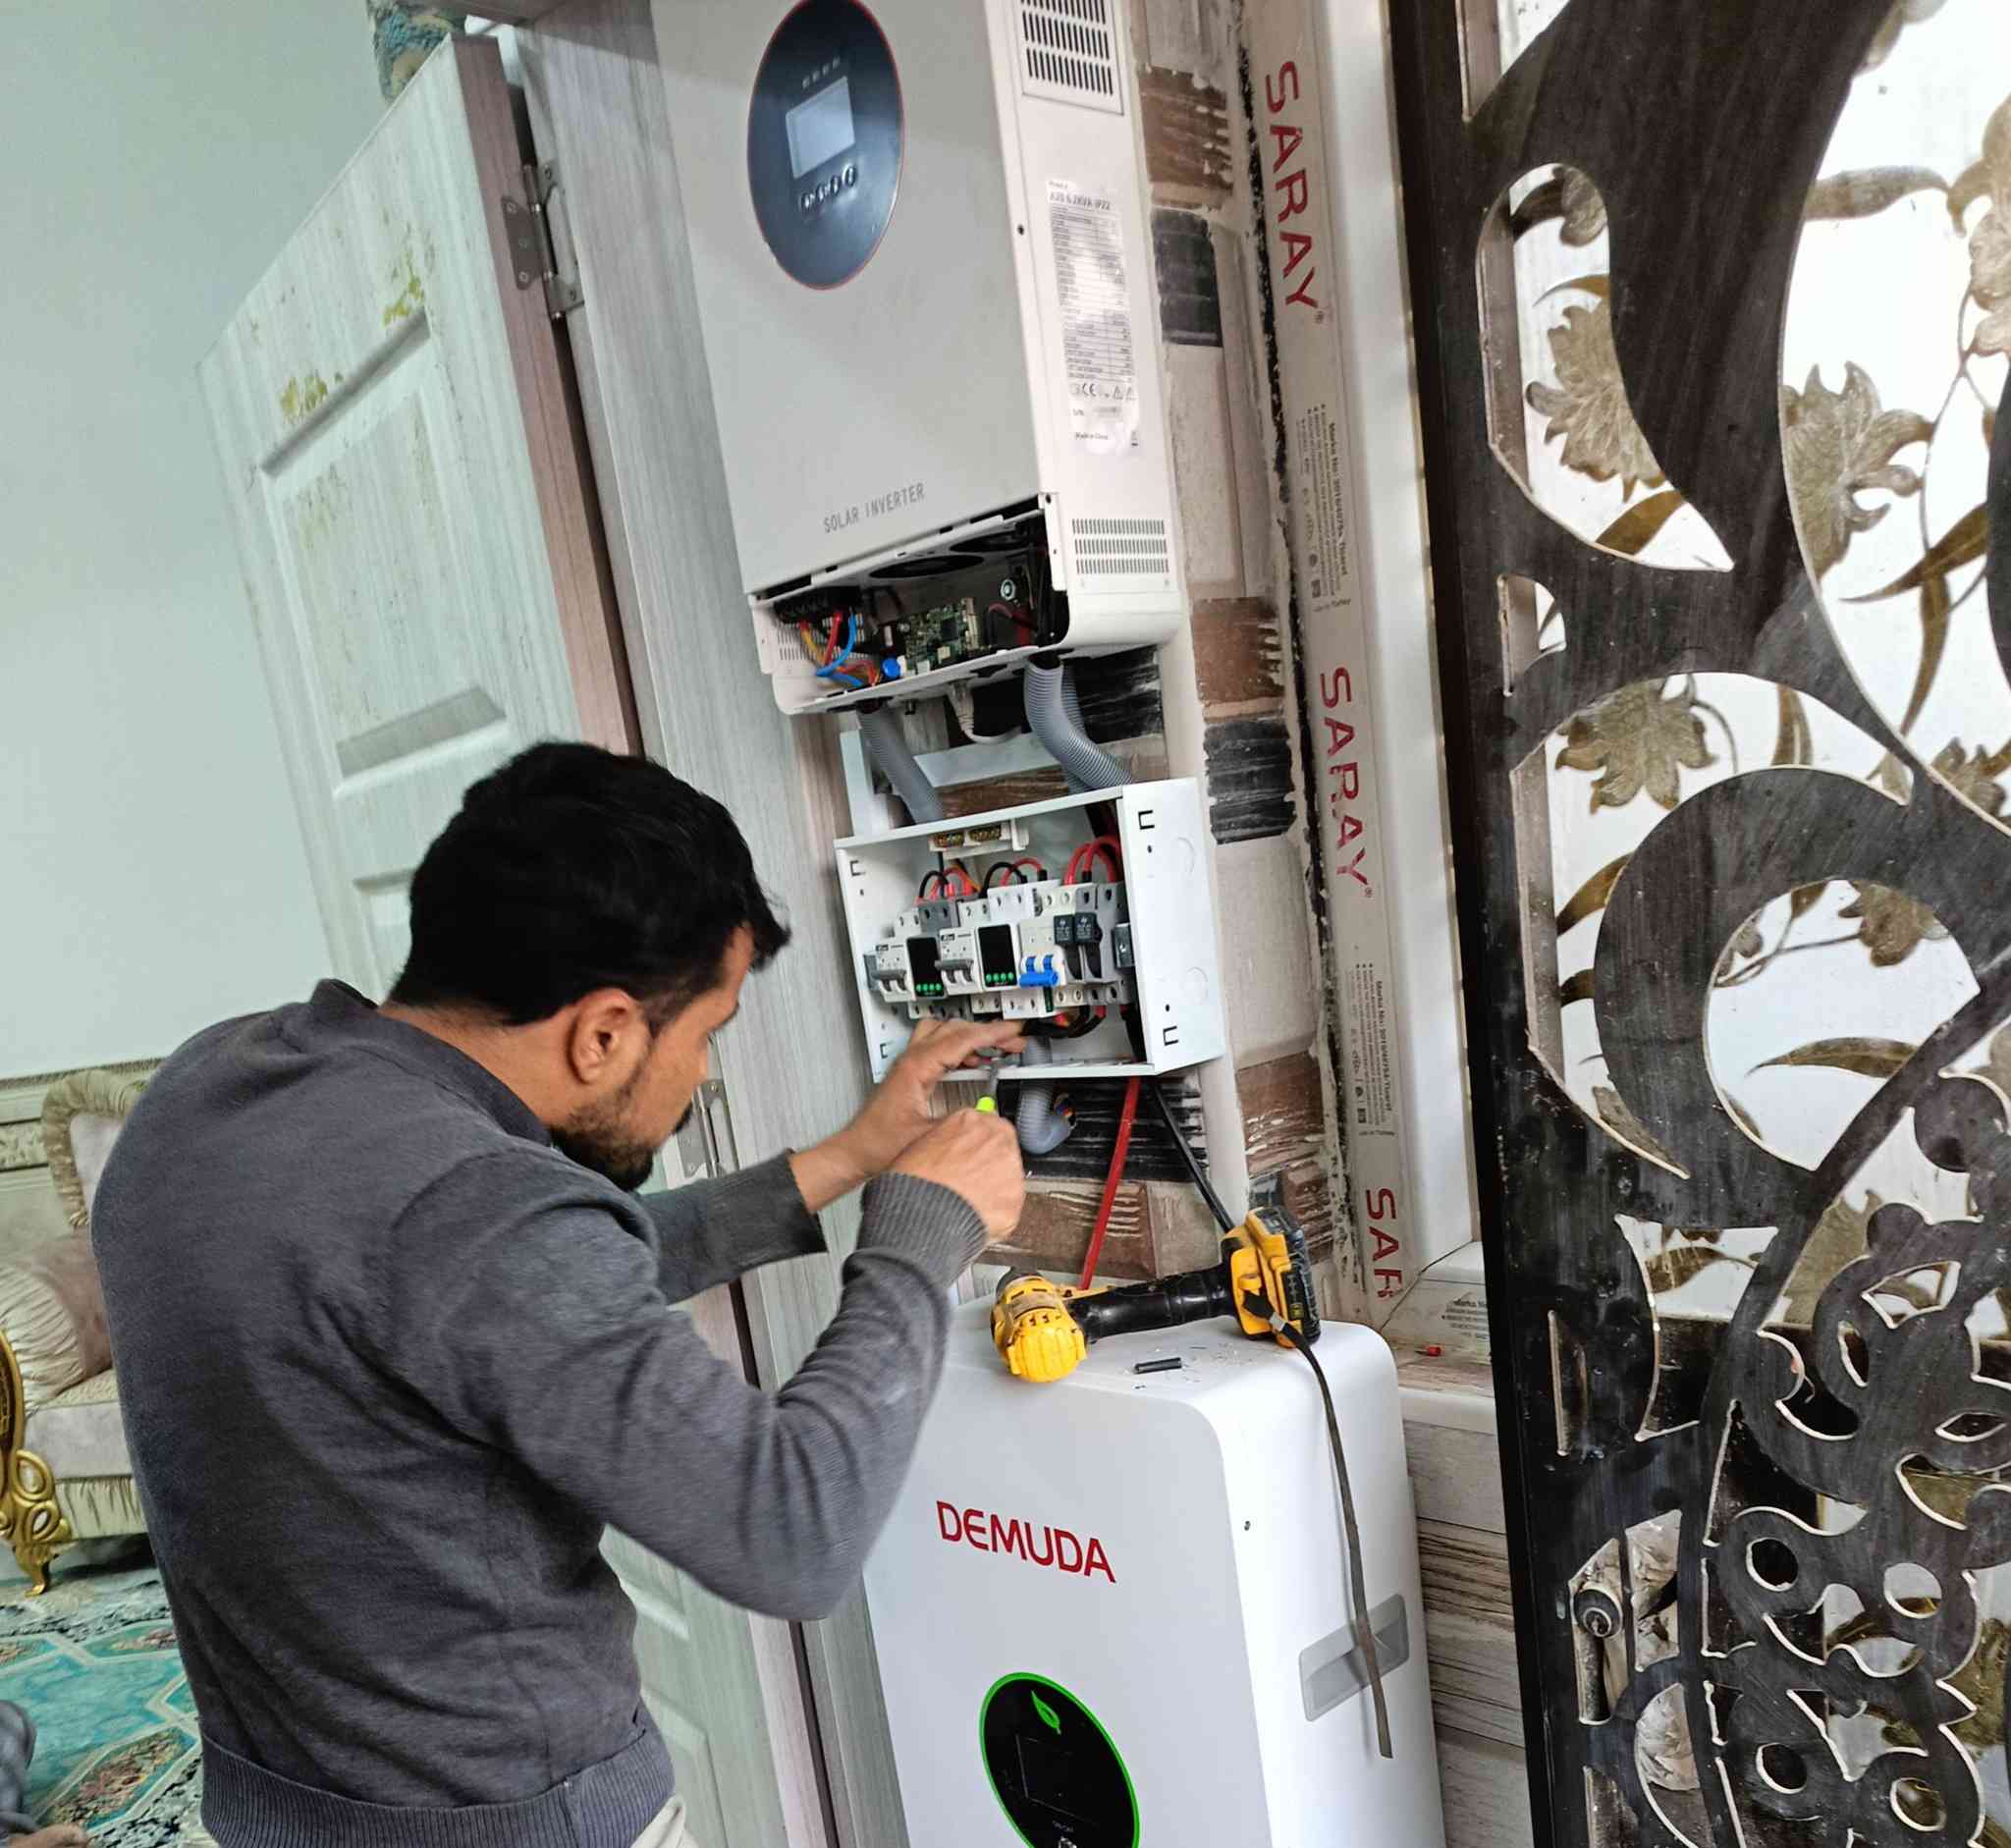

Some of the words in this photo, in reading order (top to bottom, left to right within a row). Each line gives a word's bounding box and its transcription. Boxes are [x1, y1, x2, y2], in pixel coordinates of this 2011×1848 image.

[1265, 61, 1319, 309] SARAY
[824, 506, 859, 533] SOLAR
[865, 482, 925, 518] INVERTER
[936, 1499, 1116, 1583] DEMUDA
